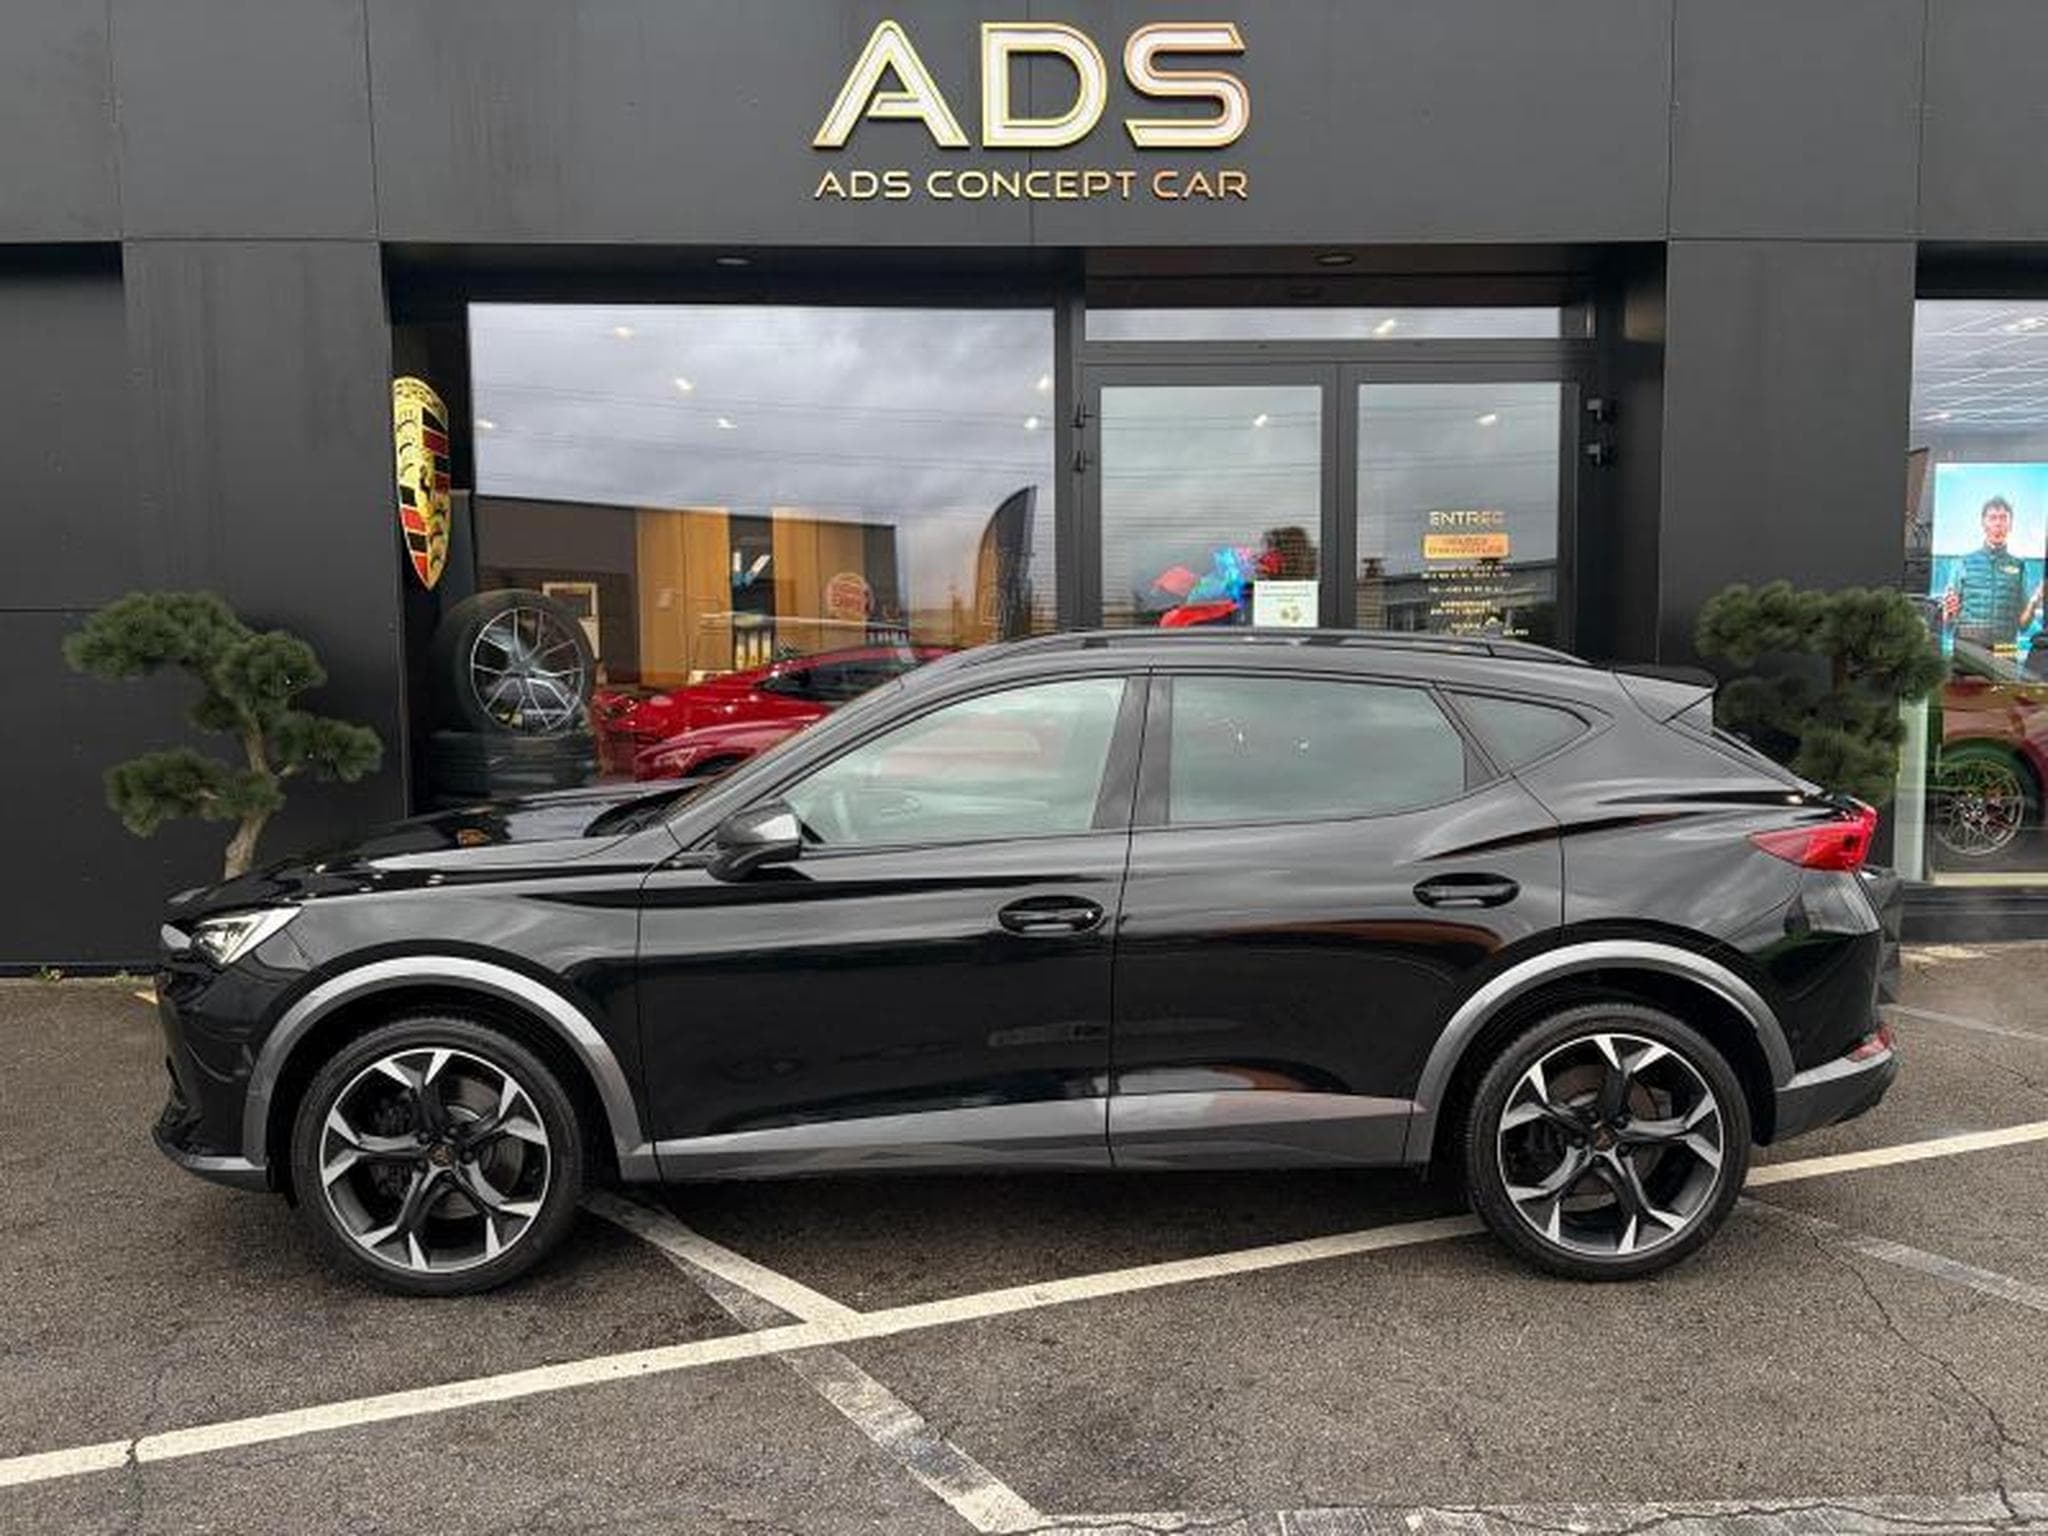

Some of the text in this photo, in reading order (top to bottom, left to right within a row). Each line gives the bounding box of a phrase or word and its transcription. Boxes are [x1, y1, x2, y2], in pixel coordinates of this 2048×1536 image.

[812, 19, 1250, 149] ADS
[814, 170, 1248, 198] ADS CONCEPT CAR
